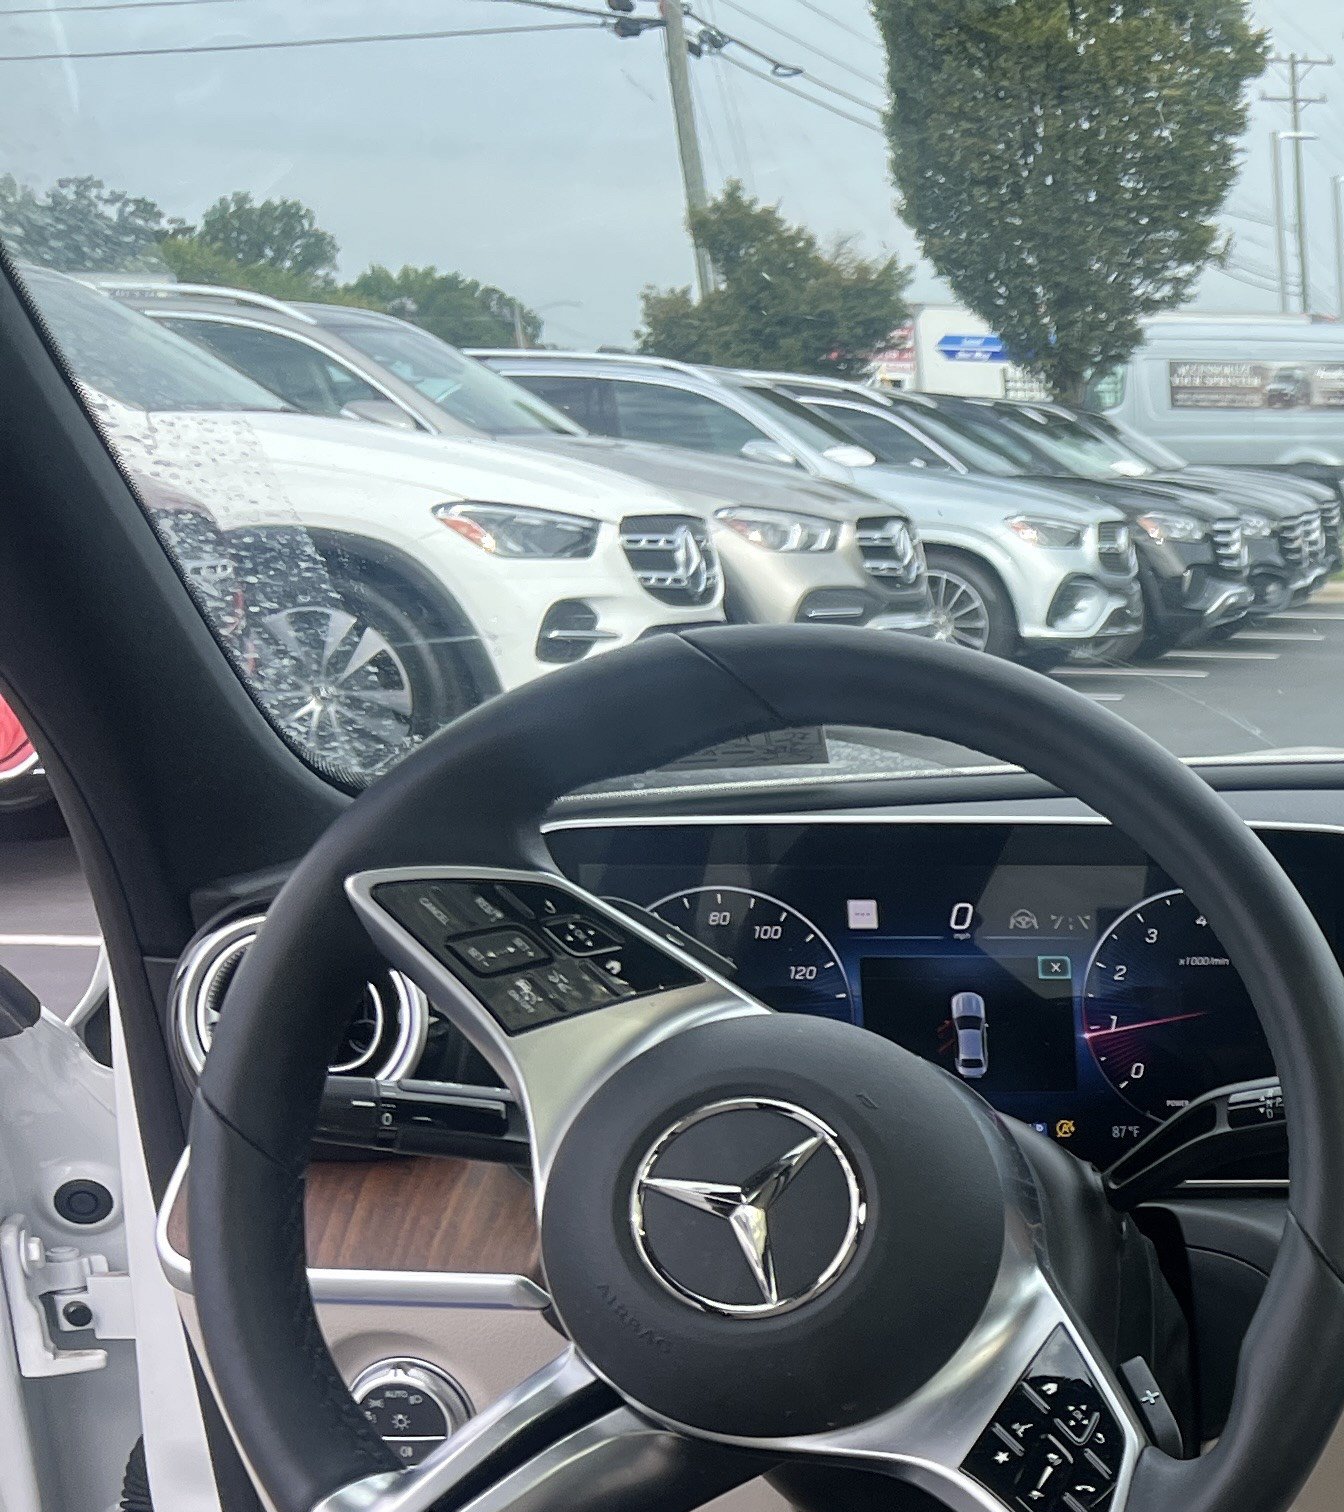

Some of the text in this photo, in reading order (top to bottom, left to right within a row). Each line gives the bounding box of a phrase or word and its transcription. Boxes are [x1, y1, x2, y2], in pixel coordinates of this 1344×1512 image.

[708, 911, 730, 926] 80
[949, 902, 974, 930] 0
[754, 925, 782, 939] 100
[1145, 929, 1158, 943] 3
[789, 966, 817, 980] 120
[1113, 965, 1127, 980] 2
[1109, 1015, 1118, 1031] 1
[1130, 1063, 1144, 1079] 0
[1111, 1125, 1140, 1138] 87°F
